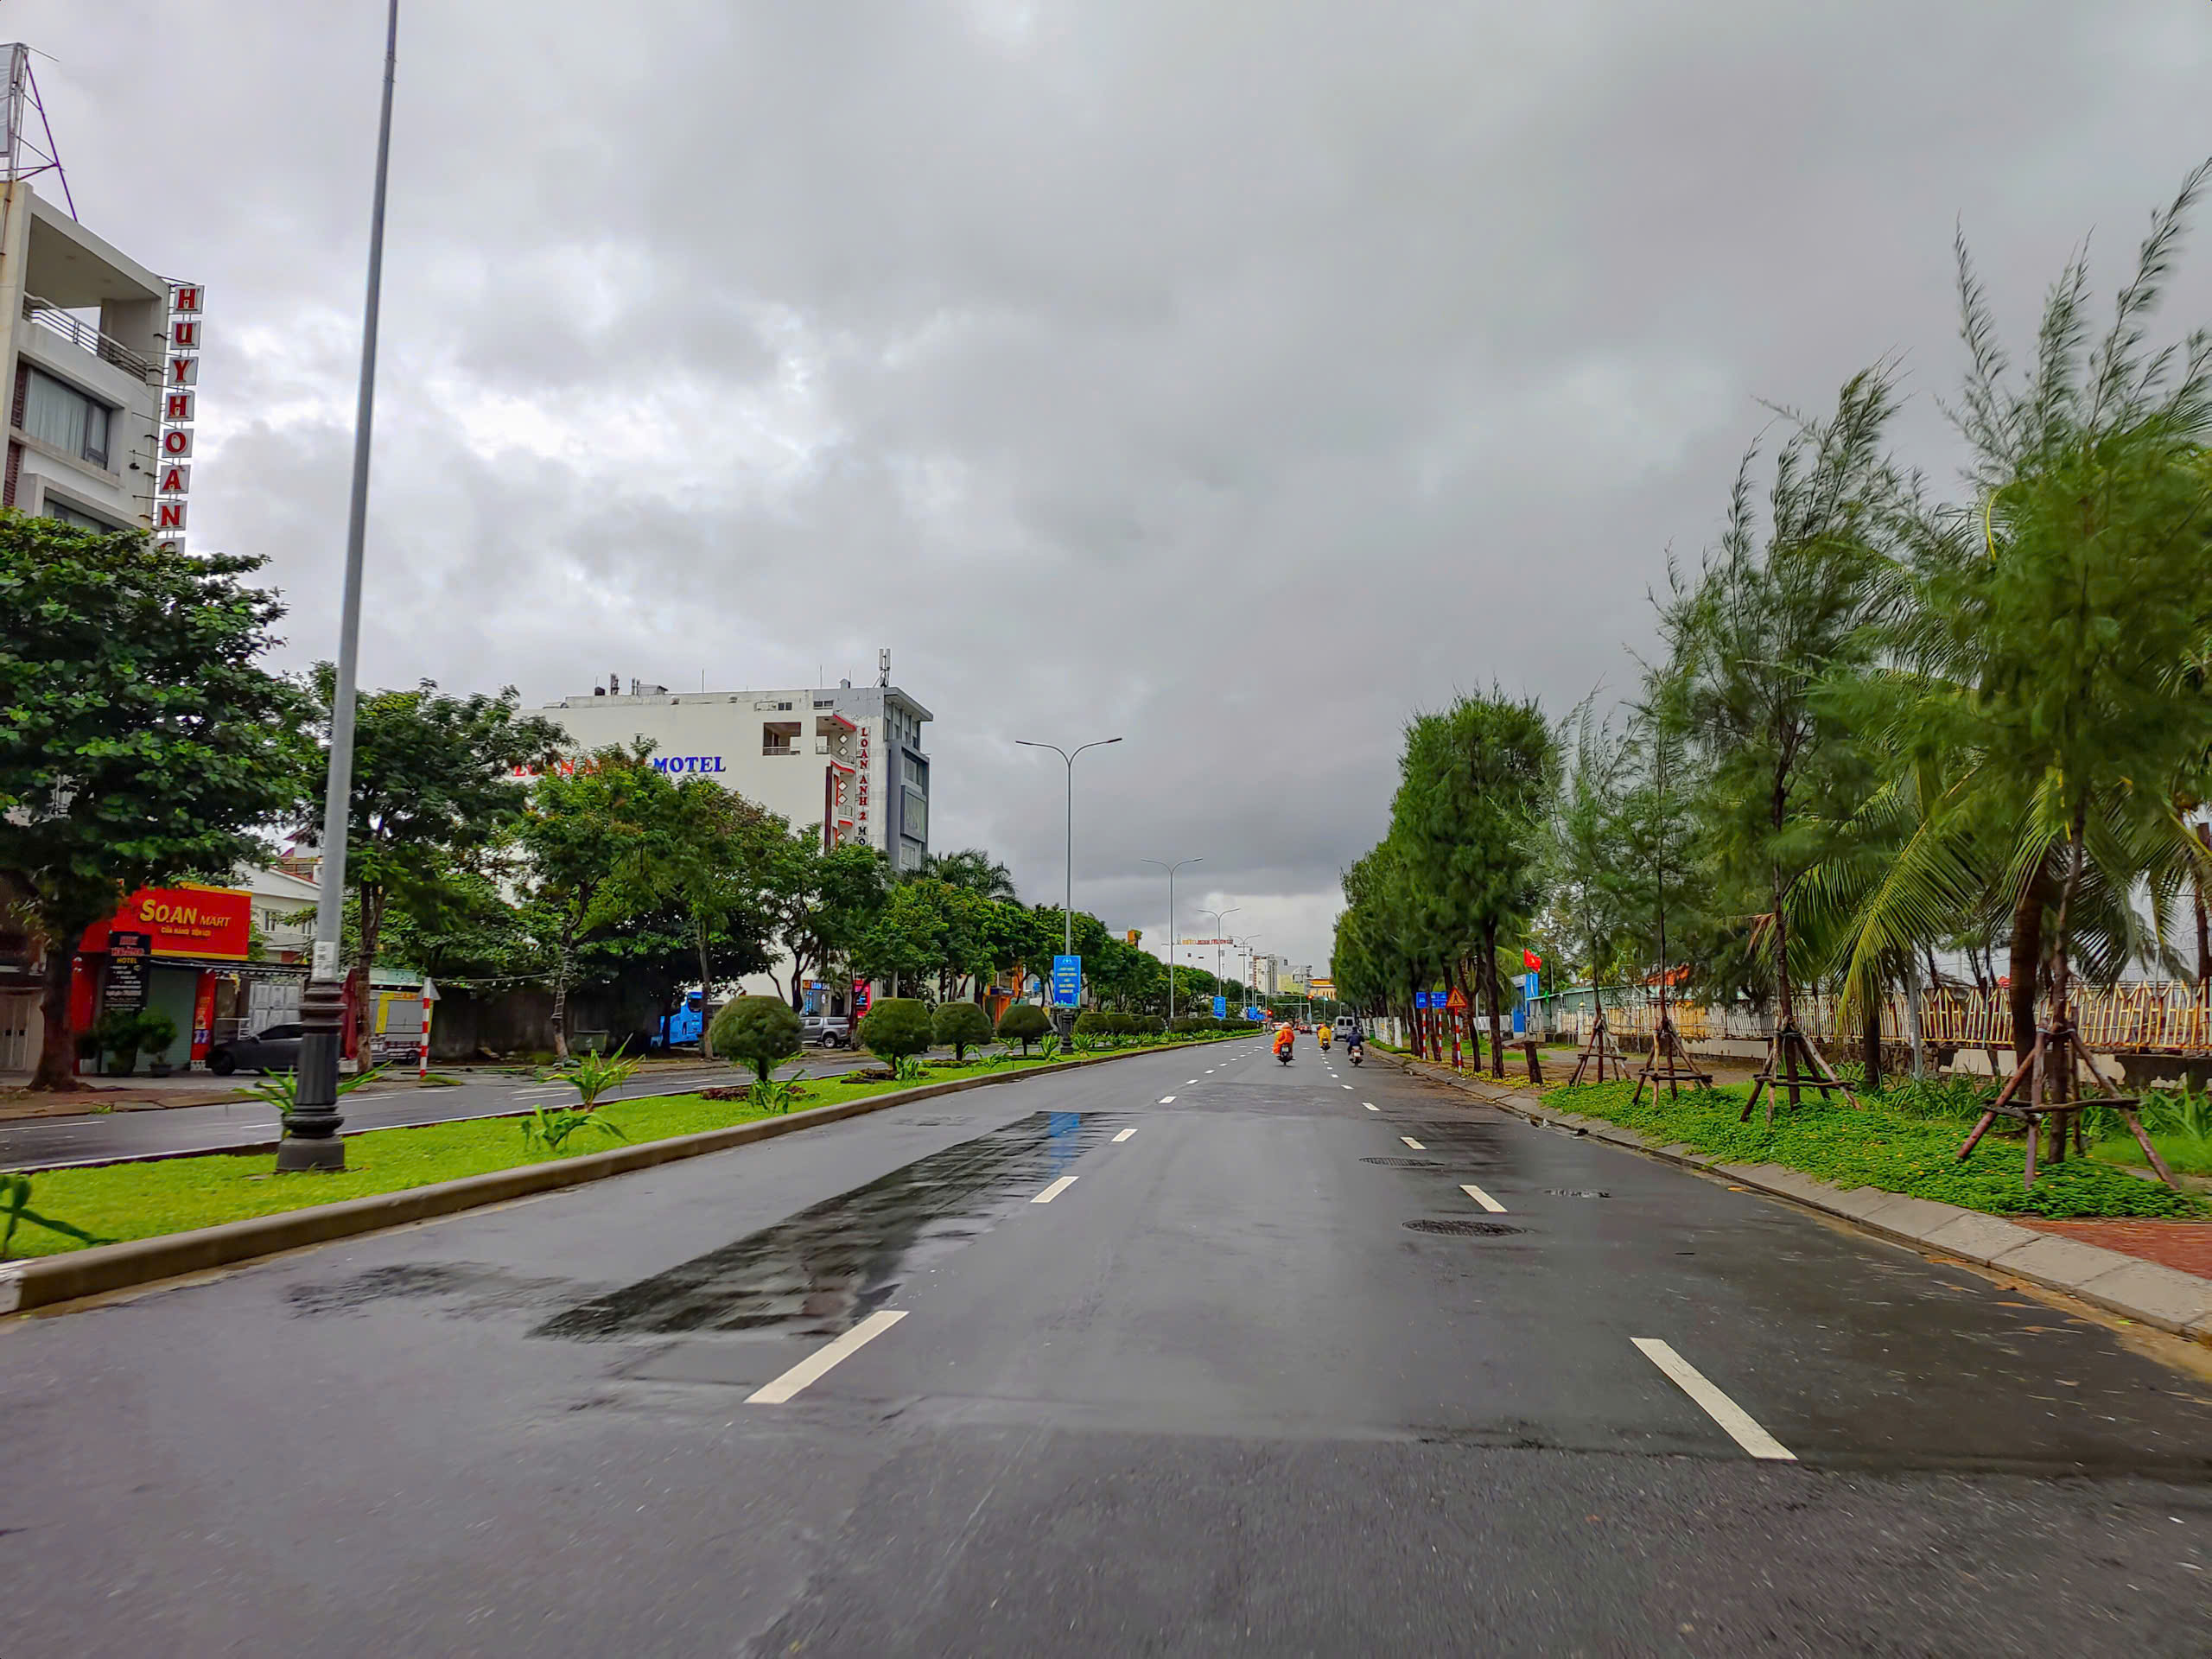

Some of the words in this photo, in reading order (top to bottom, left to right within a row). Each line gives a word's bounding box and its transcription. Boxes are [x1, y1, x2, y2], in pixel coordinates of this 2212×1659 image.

[859, 728, 868, 769] LOAN
[653, 756, 727, 774] MOTEL
[859, 774, 868, 806] ANH
[858, 811, 867, 821] 2
[200, 915, 232, 927] MART
